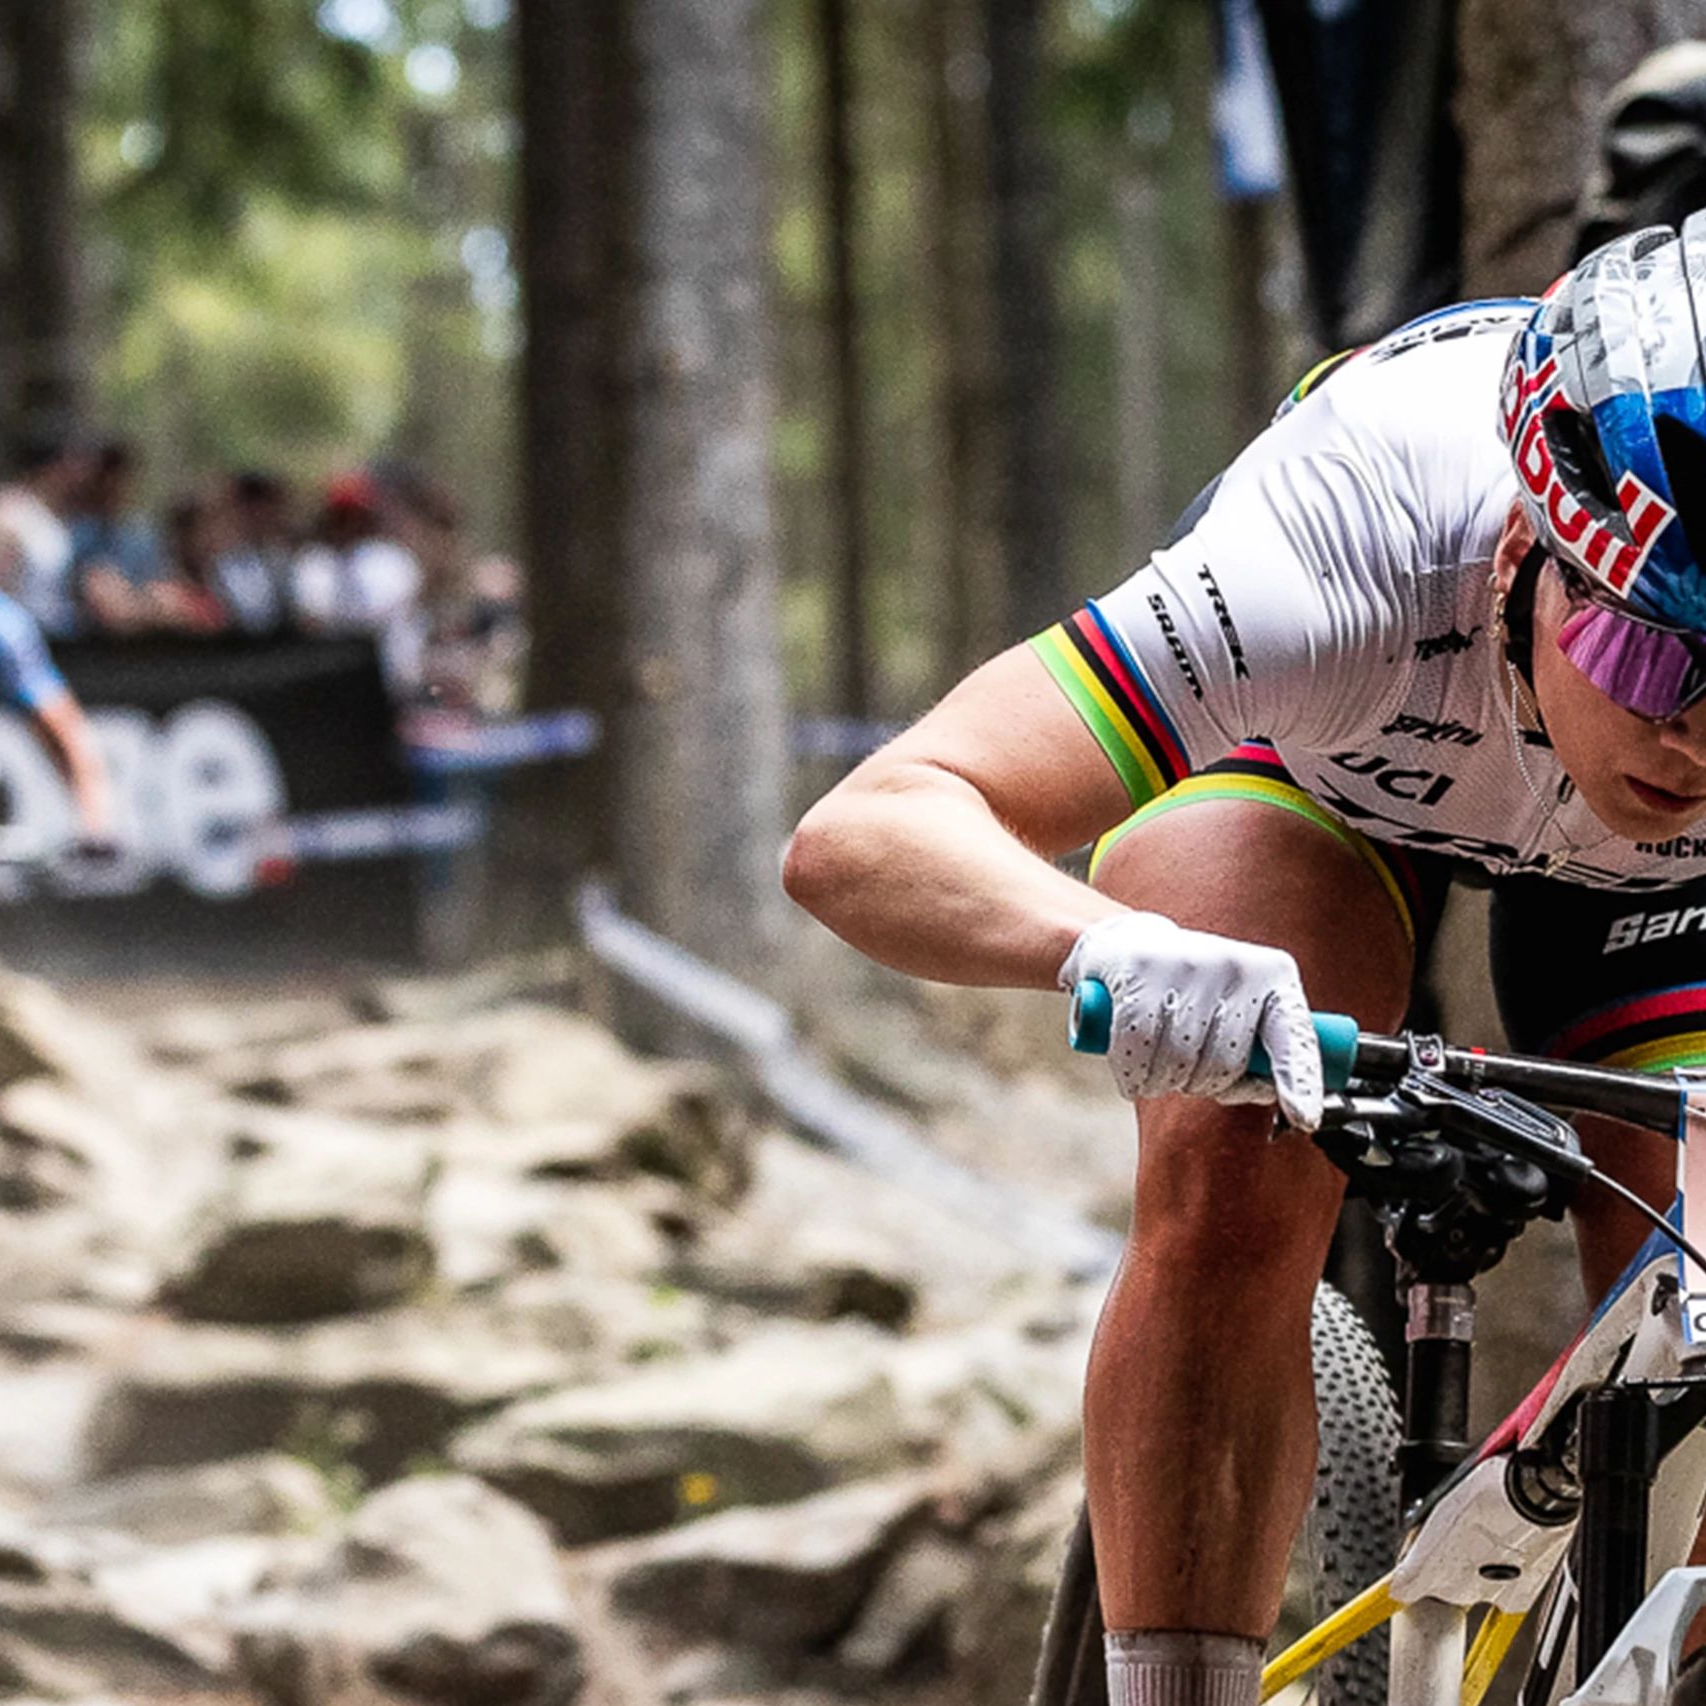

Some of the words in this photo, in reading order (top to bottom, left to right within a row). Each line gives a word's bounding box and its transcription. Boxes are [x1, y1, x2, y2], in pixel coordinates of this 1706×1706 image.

[1147, 593, 1204, 702] SRAM
[1198, 563, 1250, 681] TREK
[1327, 752, 1456, 806] UCI
